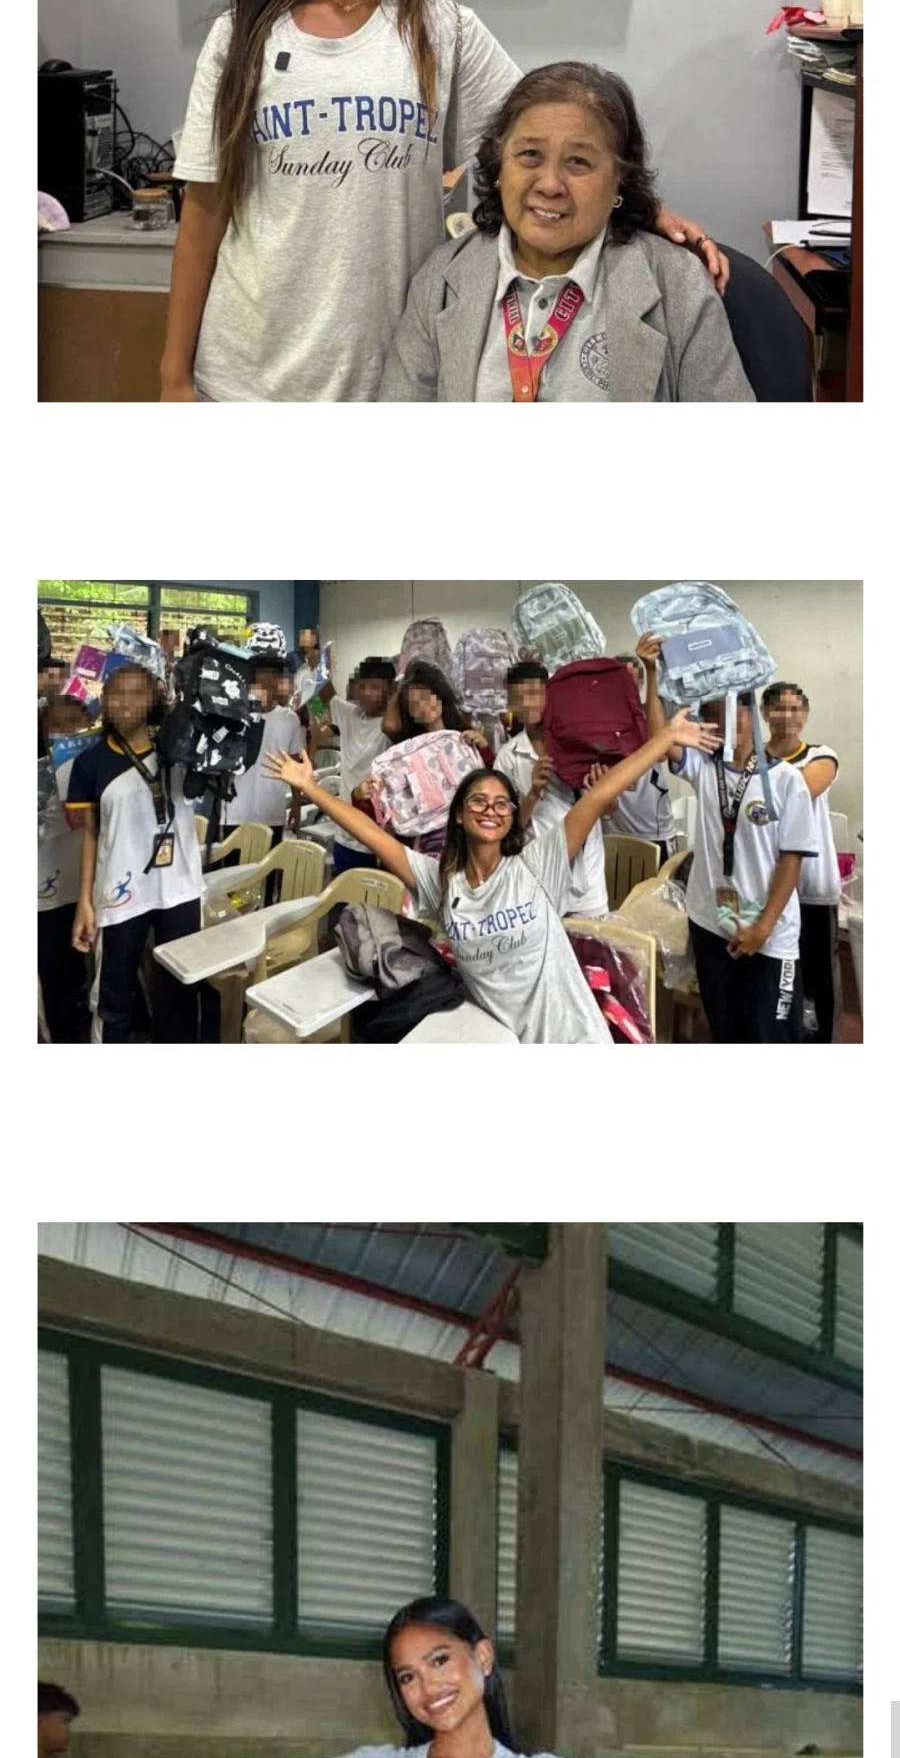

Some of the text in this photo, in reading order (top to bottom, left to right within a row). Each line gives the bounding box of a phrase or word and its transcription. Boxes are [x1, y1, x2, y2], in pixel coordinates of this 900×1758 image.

[249, 95, 439, 144] AINT-TROPEZ
[268, 137, 413, 189] Sunday Club
[492, 930, 528, 954] Club
[775, 959, 794, 1020] NEW YOR
